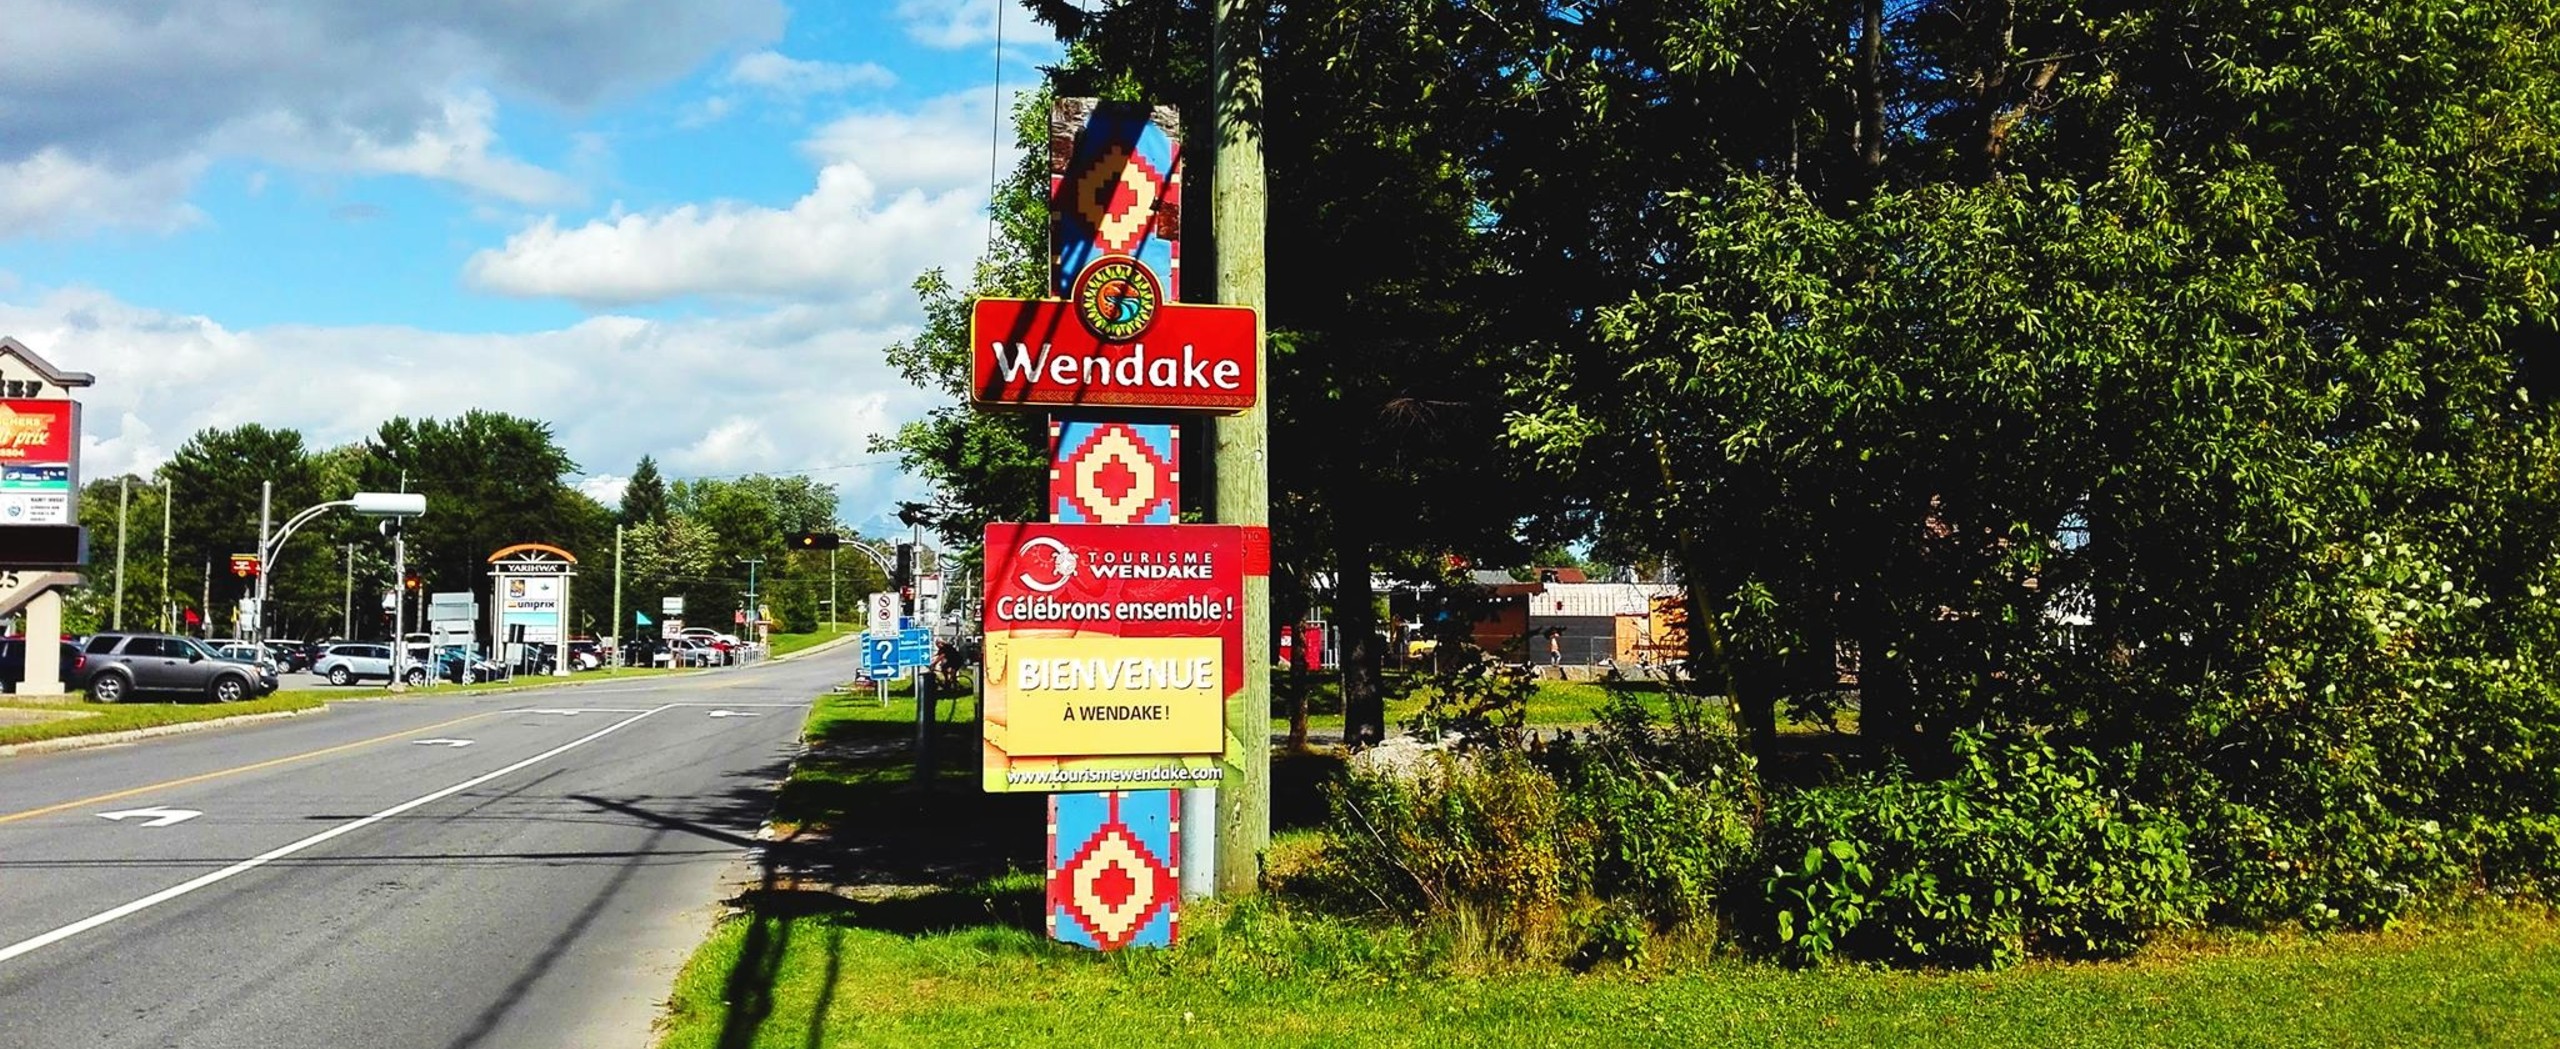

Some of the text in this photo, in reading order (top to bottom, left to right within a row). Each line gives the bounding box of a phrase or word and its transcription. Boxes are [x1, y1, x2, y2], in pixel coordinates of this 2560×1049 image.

[991, 342, 1240, 390] Wendake
[1088, 551, 1212, 564] TOURISME
[1089, 564, 1213, 579] WENDAKE
[517, 601, 555, 611] uniprix
[997, 595, 1233, 621] Célébrons ensemble !
[1018, 656, 1214, 691] BIENVENUE
[1063, 702, 1075, 721] À
[1080, 705, 1162, 721] WENDAKE
[1007, 764, 1223, 785] www.tourismewendake.com
